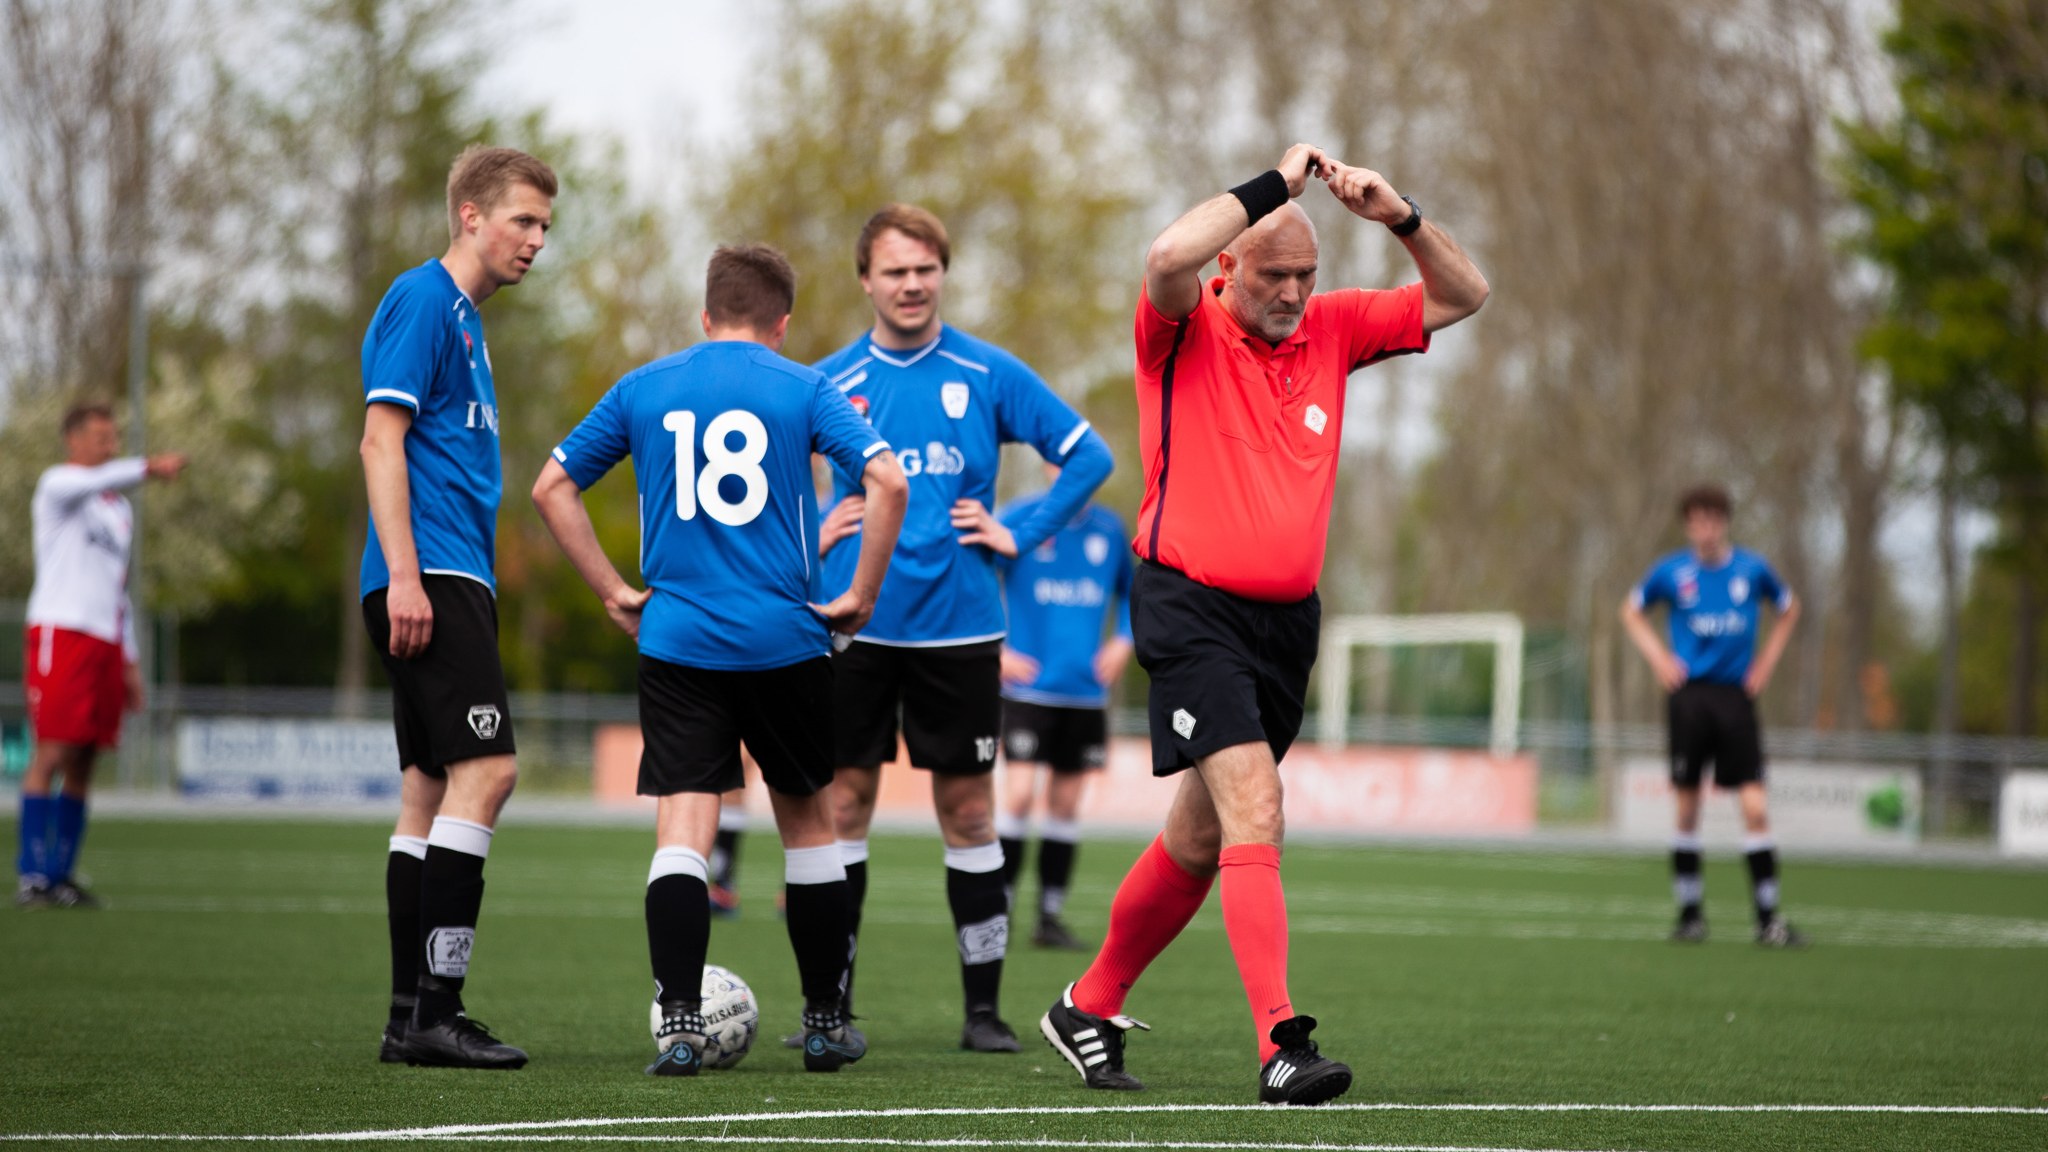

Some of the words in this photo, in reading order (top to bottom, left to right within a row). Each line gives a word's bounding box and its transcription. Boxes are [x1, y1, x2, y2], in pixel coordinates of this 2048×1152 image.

[464, 401, 499, 436] IN
[663, 409, 769, 526] 18
[975, 736, 995, 762] 10
[703, 1001, 752, 1027] DERBYSTA
